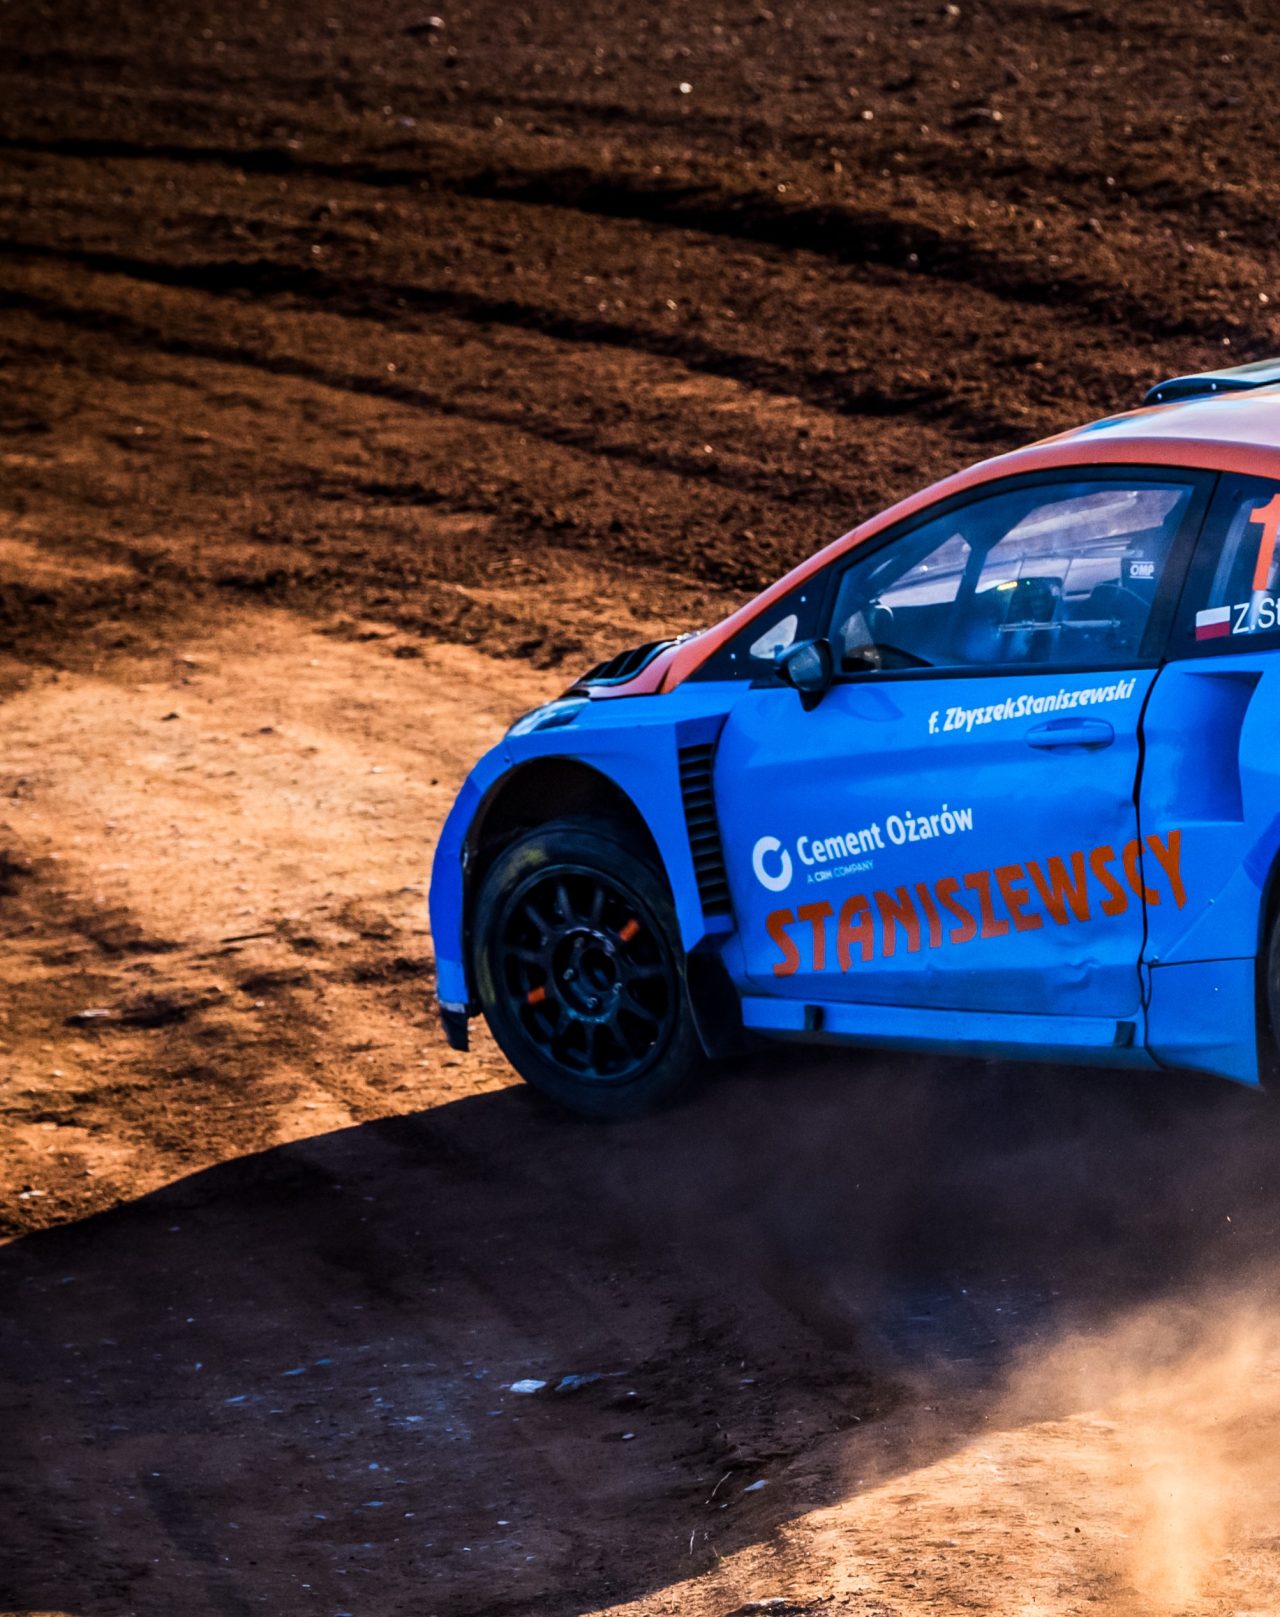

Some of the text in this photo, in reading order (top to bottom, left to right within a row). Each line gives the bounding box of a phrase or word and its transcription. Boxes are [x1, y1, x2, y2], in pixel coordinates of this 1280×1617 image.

[1130, 564, 1155, 576] OMP
[928, 678, 1137, 734] f. ZbyszekStaniszewski
[796, 803, 974, 866] Cement Ożarów
[833, 859, 875, 878] COMPANY
[765, 830, 1188, 978] STANISZEWSCY
